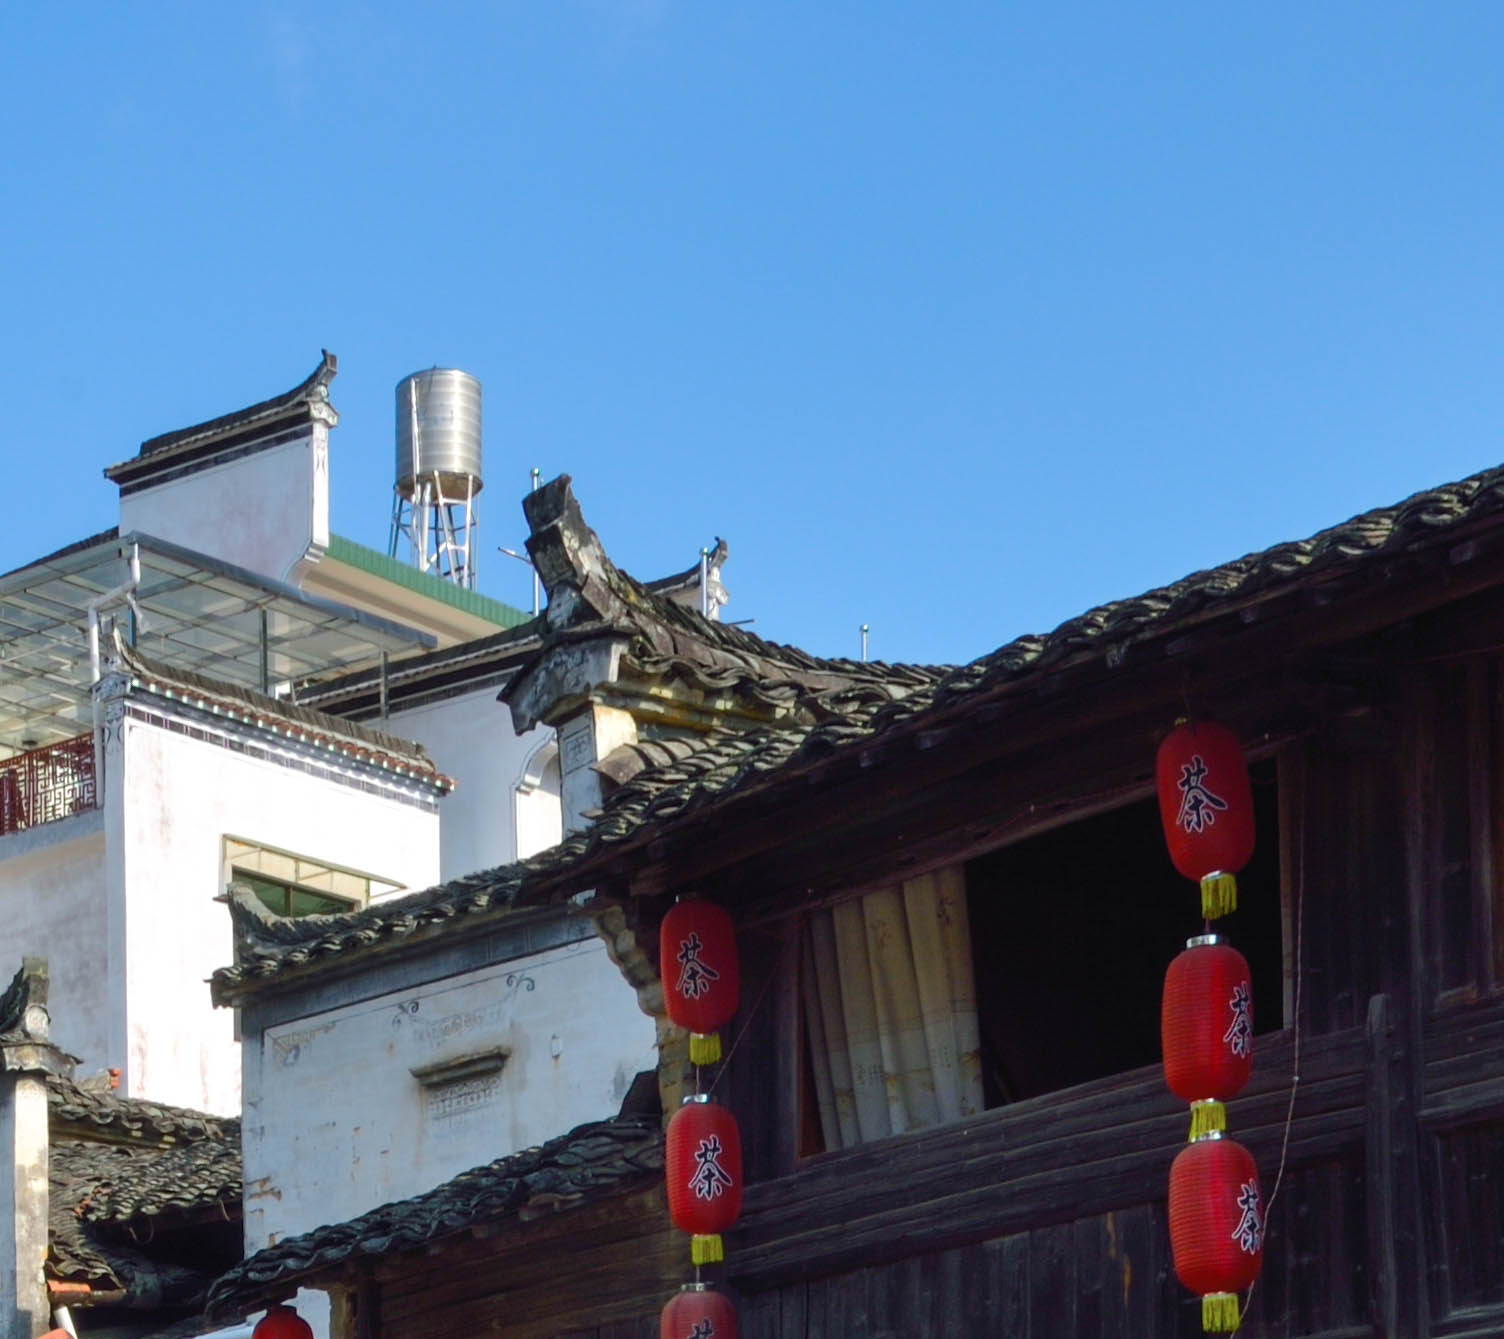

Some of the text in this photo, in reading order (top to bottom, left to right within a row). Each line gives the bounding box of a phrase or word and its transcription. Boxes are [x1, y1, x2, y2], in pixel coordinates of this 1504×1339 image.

[1175, 754, 1227, 833] 茶
[676, 931, 720, 999] 茶
[1223, 980, 1253, 1059] 茶
[689, 1134, 733, 1201] 茶
[1232, 1177, 1263, 1255] 茶
